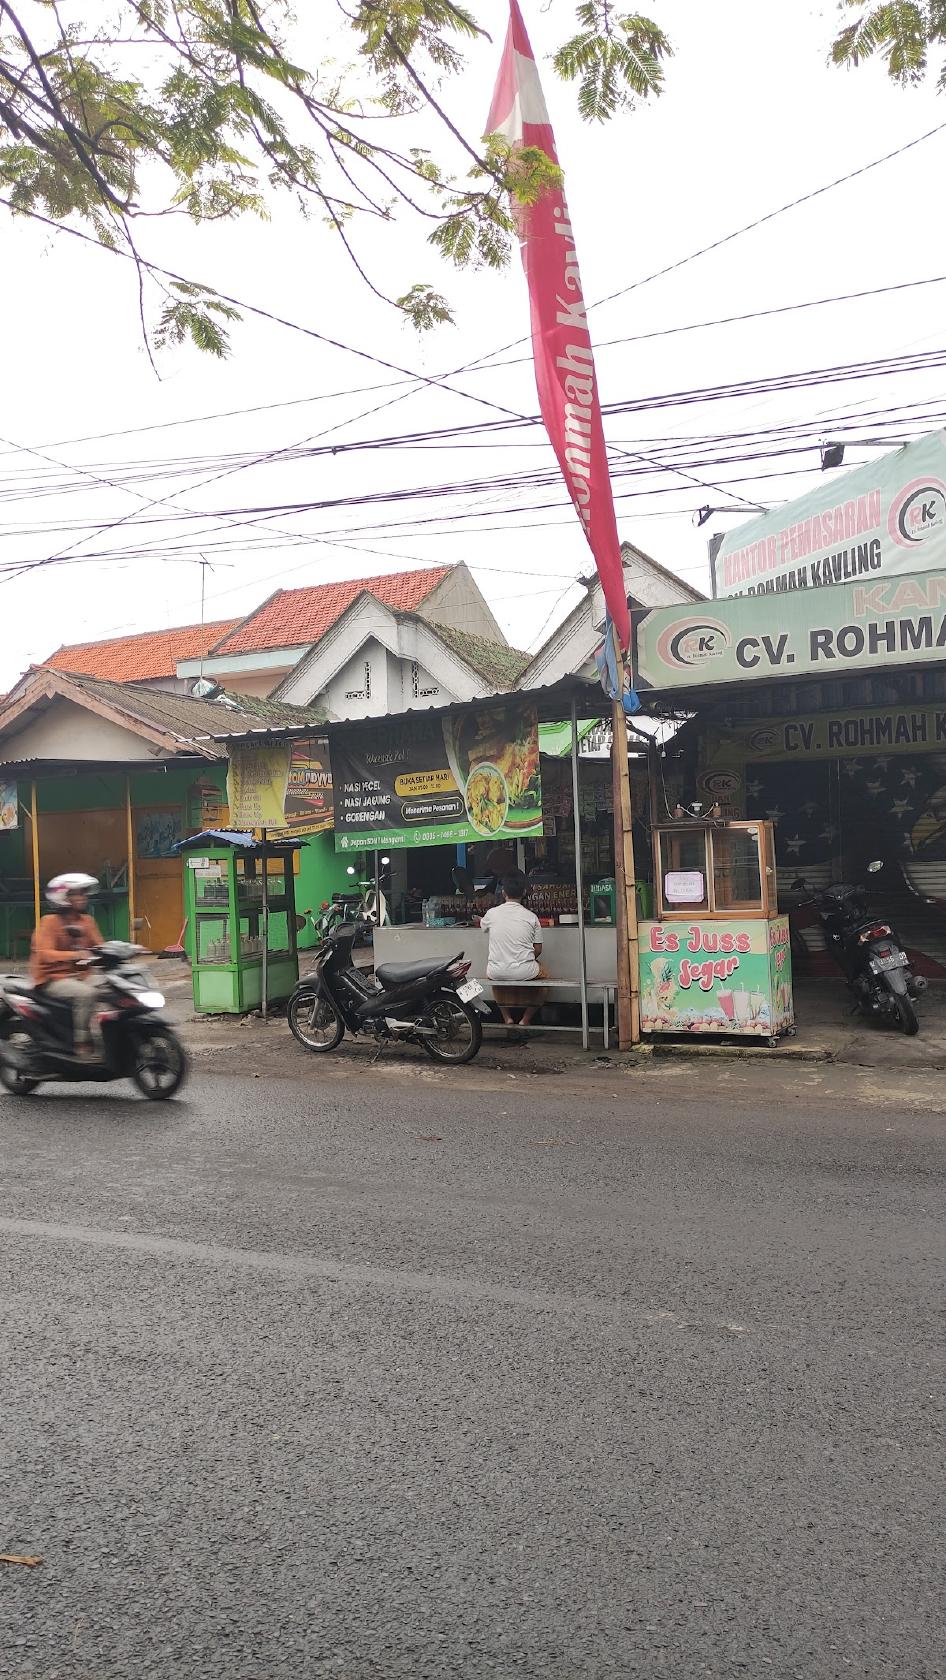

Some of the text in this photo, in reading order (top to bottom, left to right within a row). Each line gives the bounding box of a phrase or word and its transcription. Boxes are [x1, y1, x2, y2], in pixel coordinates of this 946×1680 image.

[723, 489, 881, 588] KANTOR PEMASARAN
[811, 539, 882, 586] KAVLING
[736, 635, 795, 668] CV.
[785, 723, 822, 750] CV.
[828, 714, 927, 748] ROHMAH
[344, 782, 361, 793] NASI
[344, 795, 391, 808] NASI JAGUNG
[345, 811, 386, 822] GORENGAN
[650, 926, 679, 951] Es
[688, 926, 751, 952] Juss
[680, 956, 739, 990] Segar
